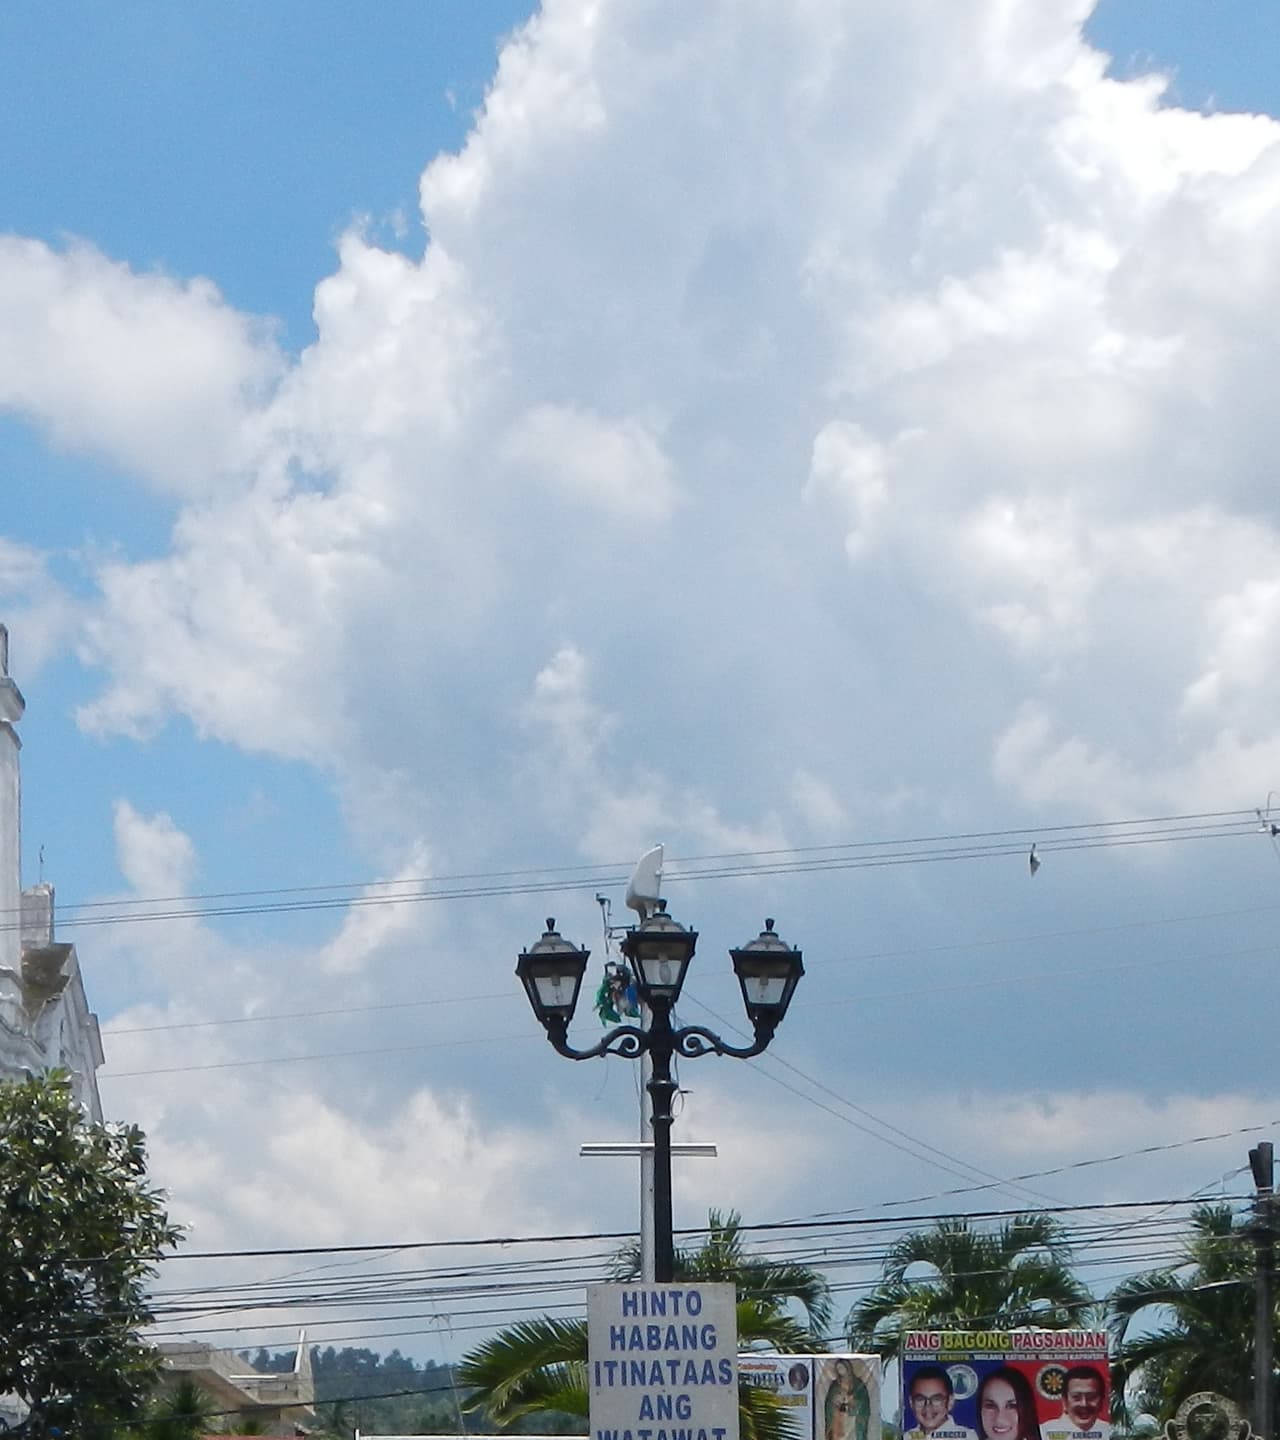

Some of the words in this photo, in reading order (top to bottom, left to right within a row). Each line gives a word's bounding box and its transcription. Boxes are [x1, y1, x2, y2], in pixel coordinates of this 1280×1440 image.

[622, 1290, 702, 1317] HINTO
[610, 1323, 717, 1351] HABANG
[905, 1333, 940, 1350] ANG
[943, 1332, 1011, 1350] BAGONG
[1012, 1332, 1107, 1349] PAGSANJAN
[594, 1358, 733, 1387] ITINATAAS
[639, 1394, 692, 1421] ANG
